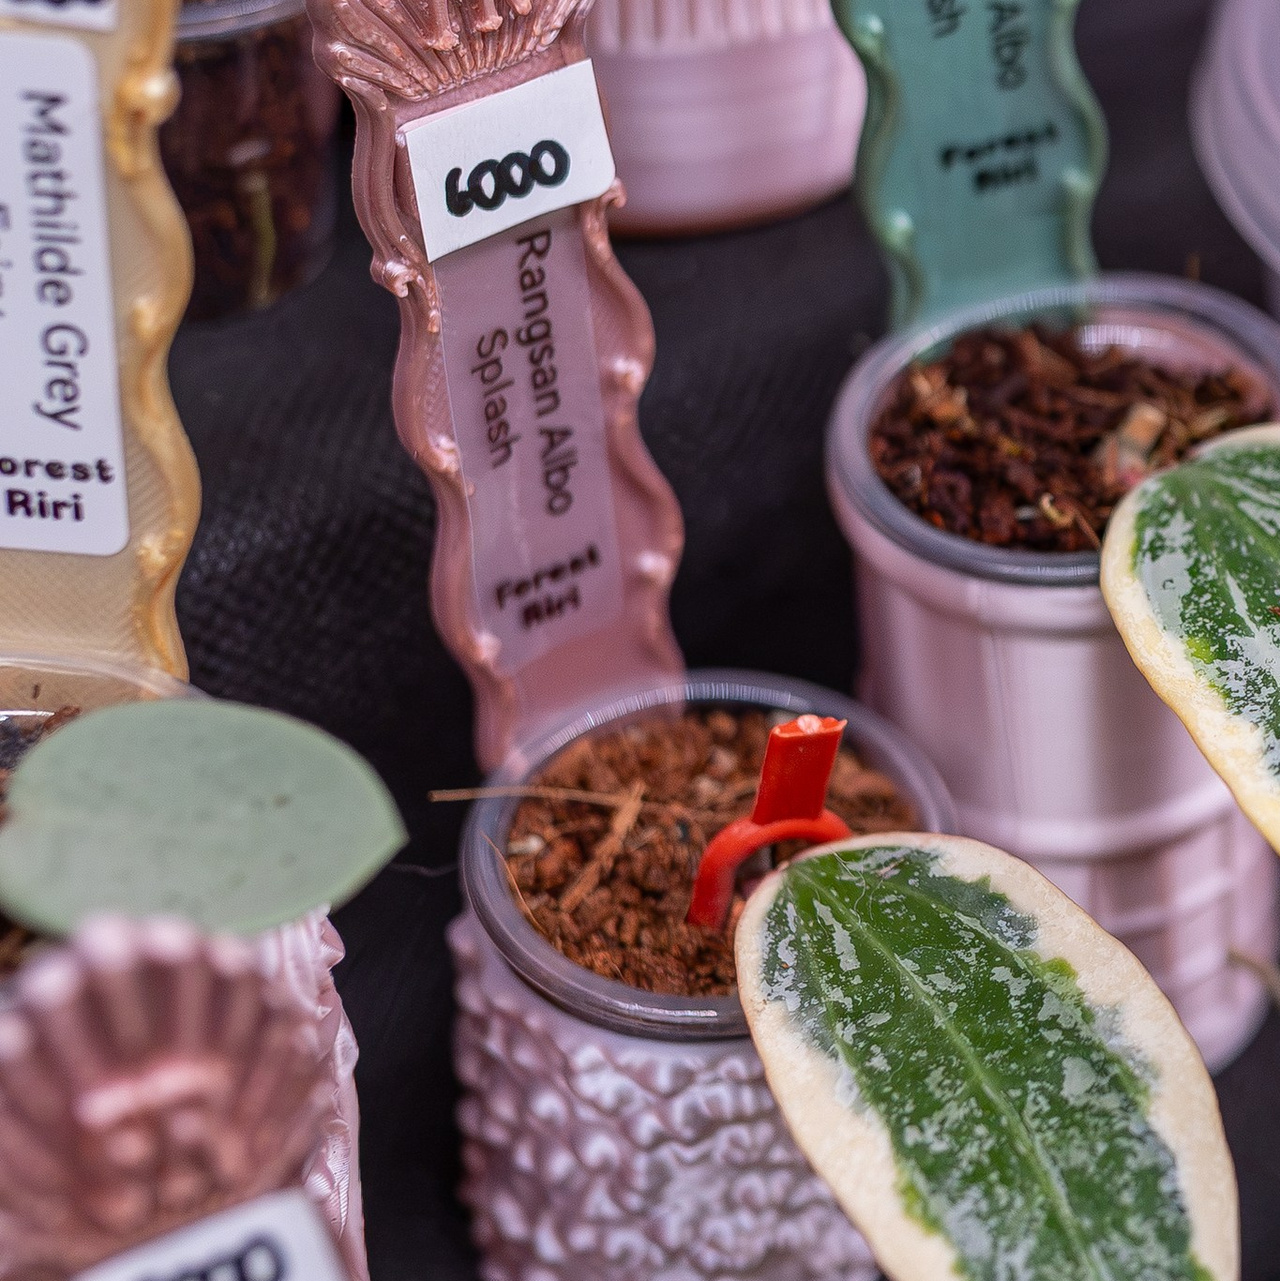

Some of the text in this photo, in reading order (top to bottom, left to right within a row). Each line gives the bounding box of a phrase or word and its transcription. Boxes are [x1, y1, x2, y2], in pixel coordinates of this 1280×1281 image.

[444, 138, 571, 218] 6000
[20, 89, 90, 432] Mathilde Grey
[471, 326, 521, 470] Splash
[515, 227, 577, 518] Rangsan Albo
[0, 455, 115, 485] orest
[5, 487, 85, 522] Riri
